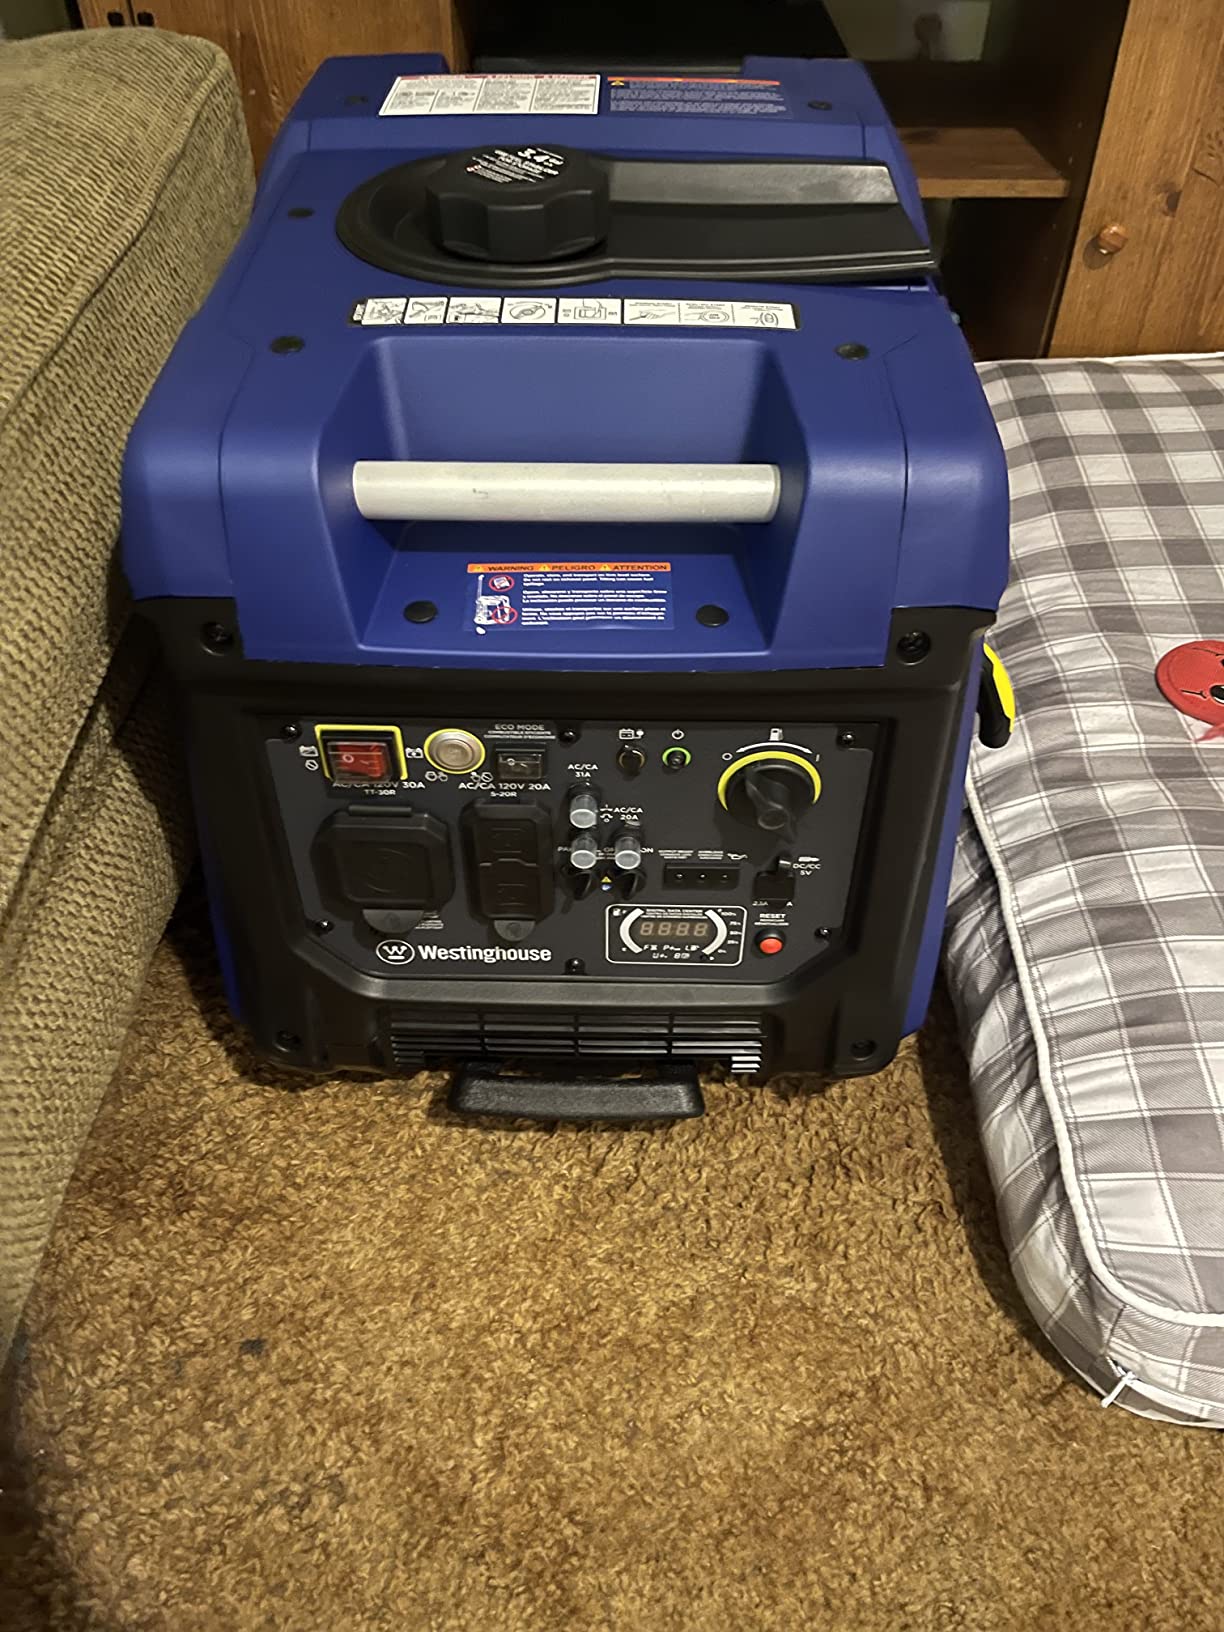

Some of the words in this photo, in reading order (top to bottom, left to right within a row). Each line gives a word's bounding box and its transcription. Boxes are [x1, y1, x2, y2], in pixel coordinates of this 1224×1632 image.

[494, 723, 520, 731] ECO
[567, 763, 599, 772] AC/CA
[401, 781, 426, 789] 30A
[457, 782, 497, 791] AC/CA
[498, 782, 526, 790] 120V
[528, 783, 552, 791] 20A
[613, 806, 644, 814] AC/CA
[792, 862, 821, 870] DC/CC
[417, 944, 552, 964] Westinghouse
